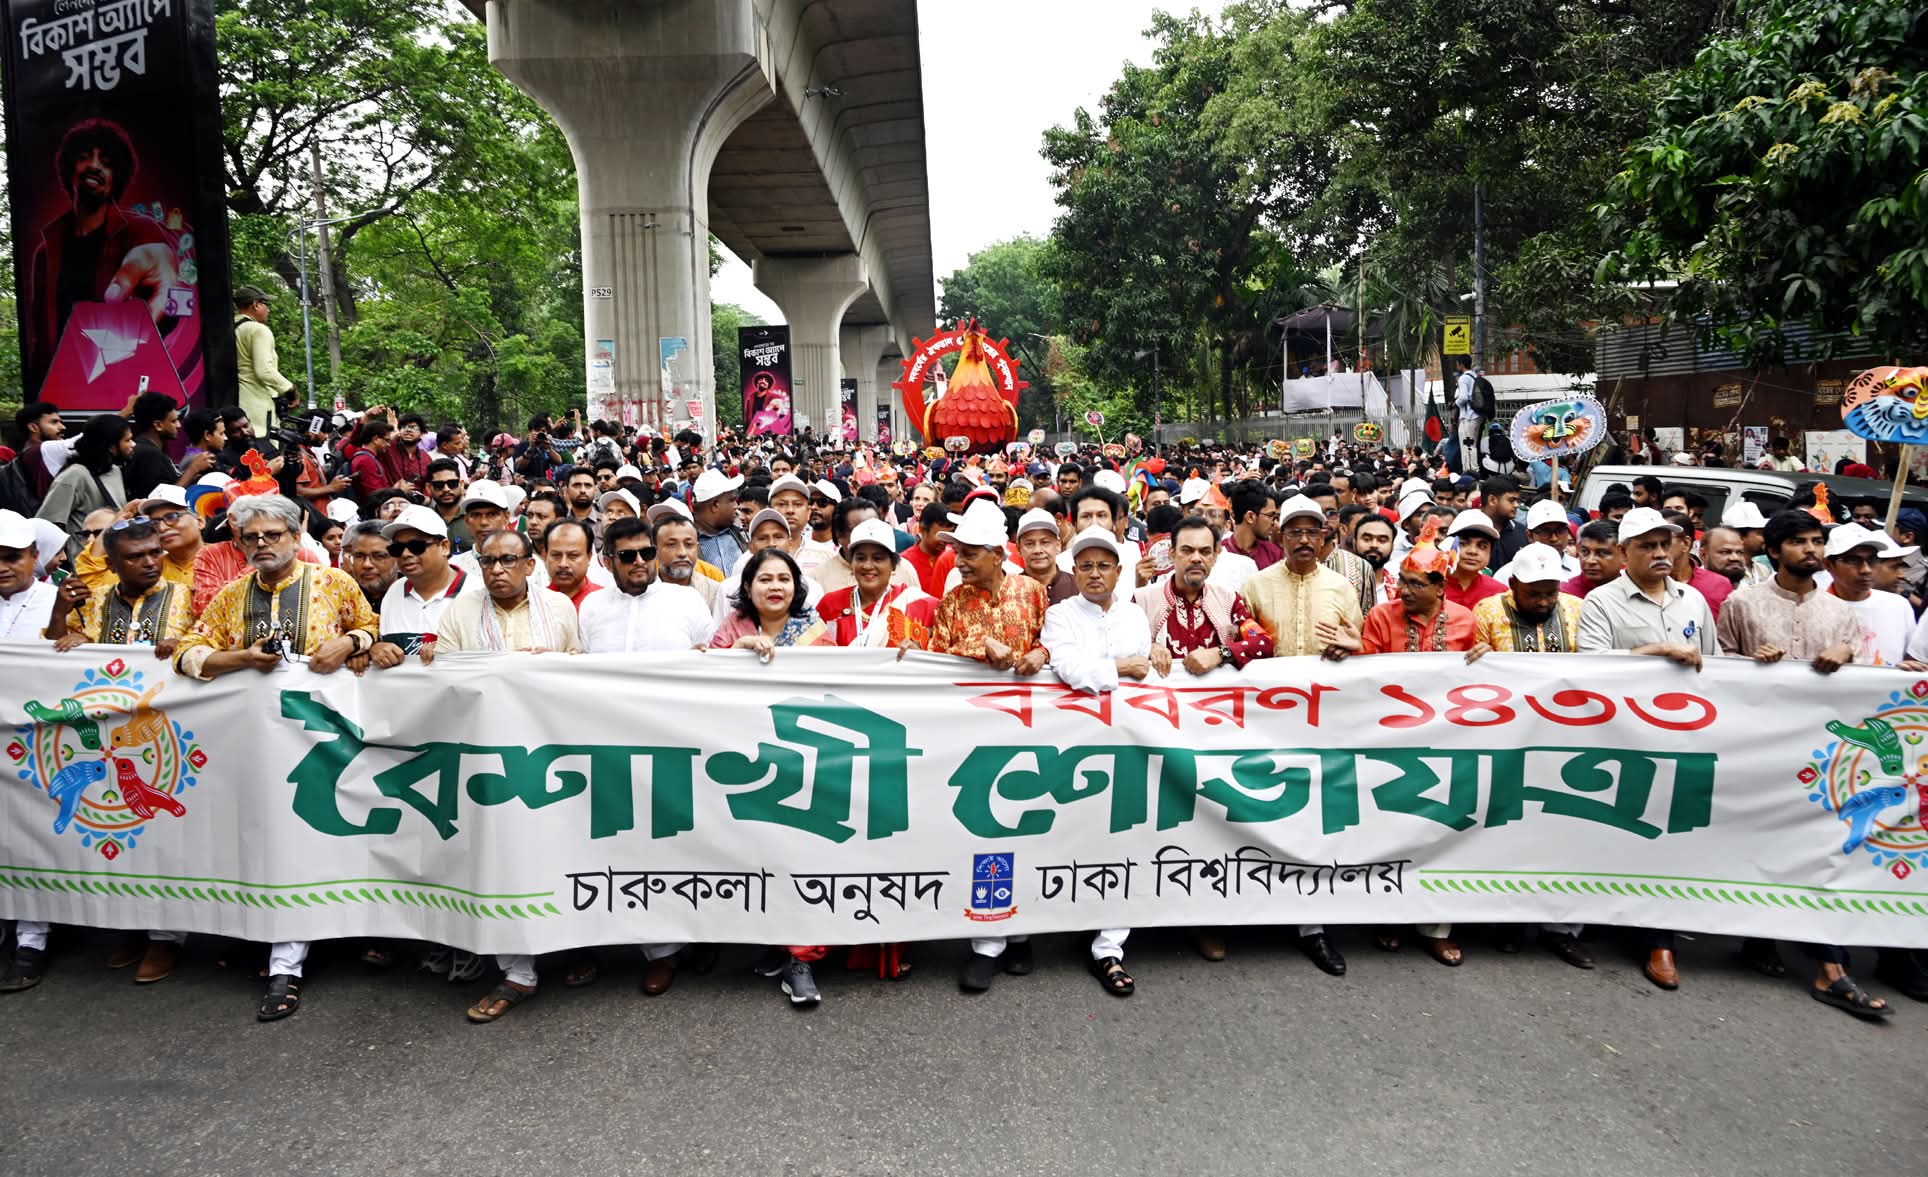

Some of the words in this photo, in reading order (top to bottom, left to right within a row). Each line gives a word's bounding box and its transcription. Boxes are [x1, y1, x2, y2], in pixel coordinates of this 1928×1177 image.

[19, 10, 94, 60] বিকাশ
[98, 0, 171, 33] অ্যাপে
[62, 27, 149, 91] সম্ভব
[755, 352, 779, 366] সম্ভব
[1378, 683, 1718, 731] ১৪৩৩
[280, 689, 924, 844] বৈশাখী
[948, 744, 1720, 840] শোভাযাত্রা
[564, 865, 775, 915] চারুকলা
[790, 871, 951, 925] অনুষদ
[1035, 857, 1139, 904] ঢাকা
[1150, 845, 1413, 899] বিশ্ববিদ্যালয়
